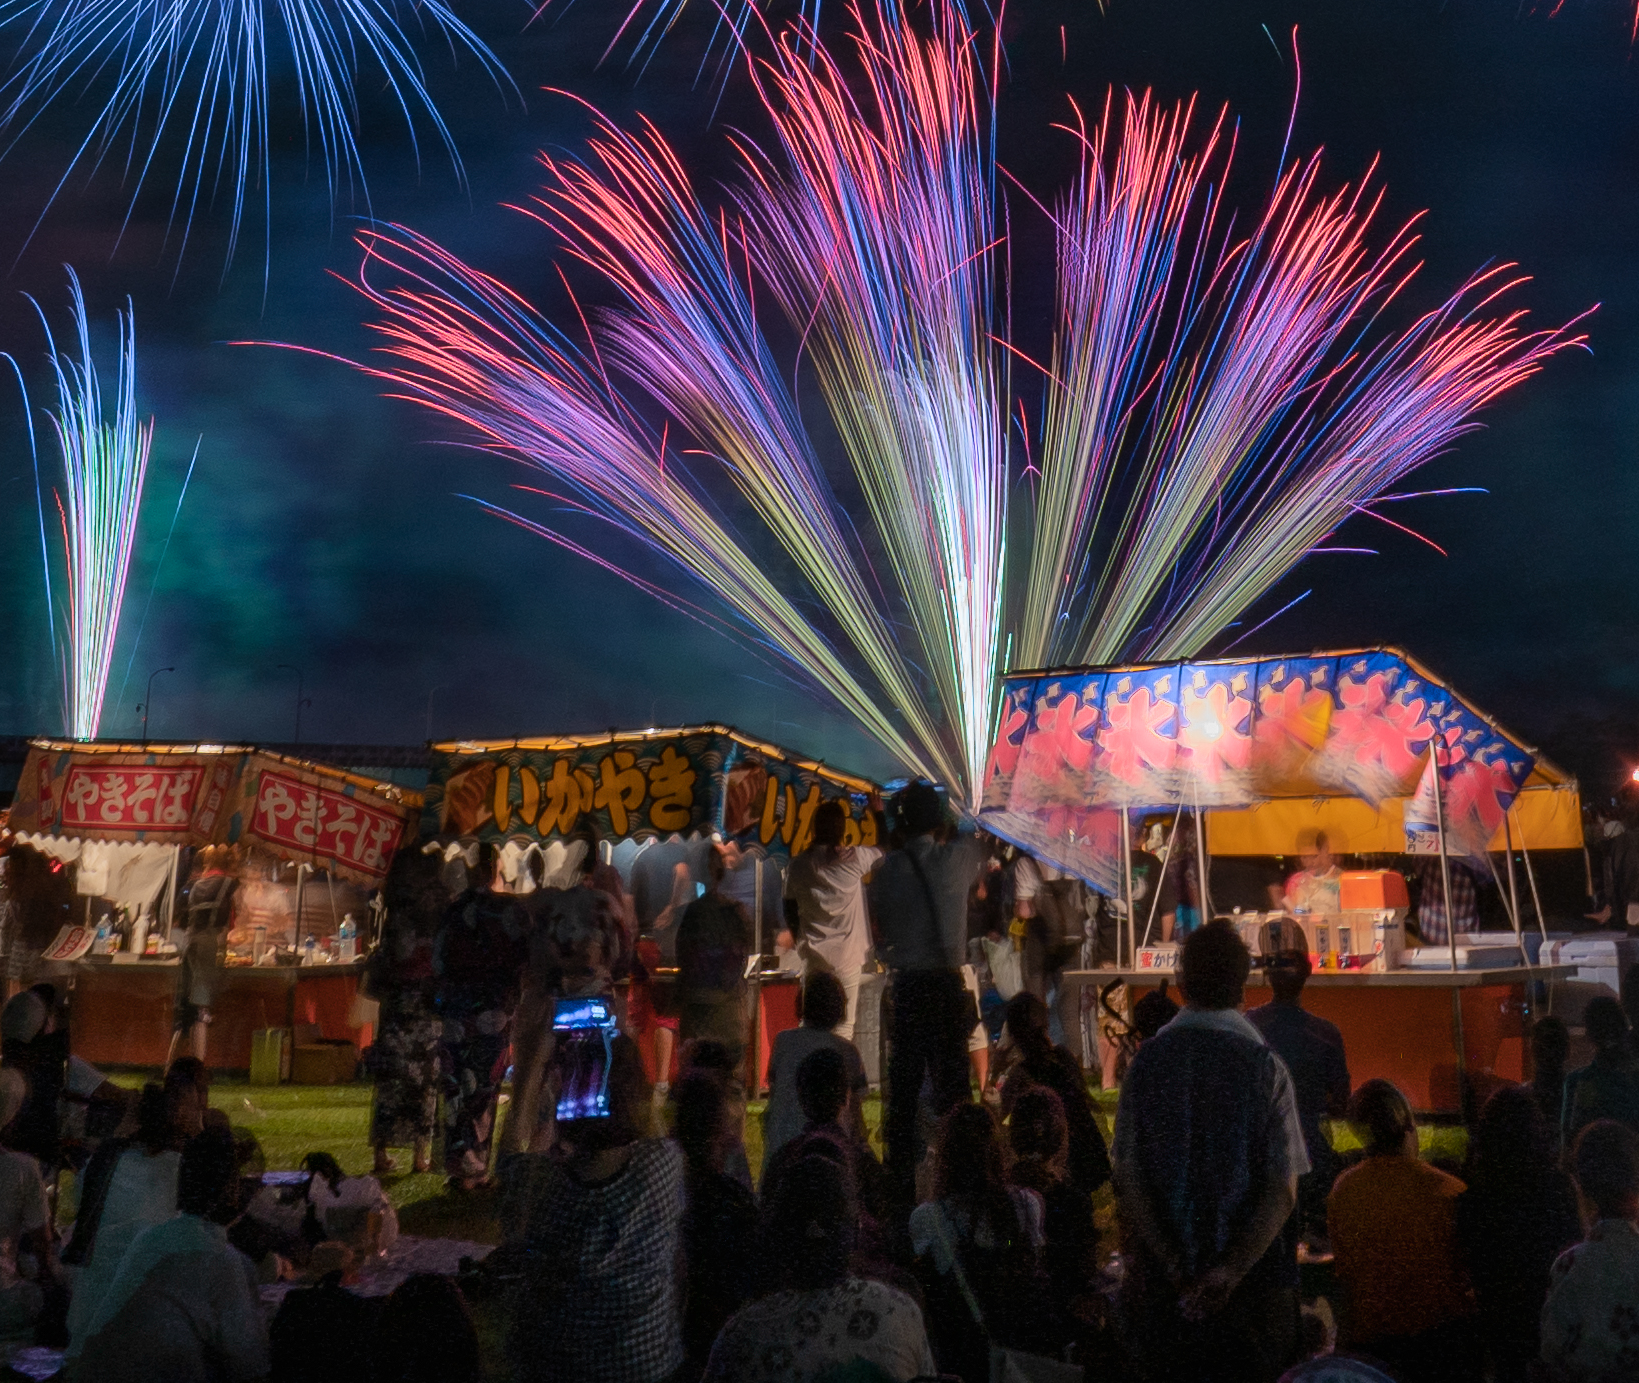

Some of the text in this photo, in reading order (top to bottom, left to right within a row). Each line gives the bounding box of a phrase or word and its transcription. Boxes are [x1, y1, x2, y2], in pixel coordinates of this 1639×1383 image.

[67, 772, 193, 824] やきそば
[259, 782, 396, 869] やきそば
[493, 745, 697, 837] いかやき
